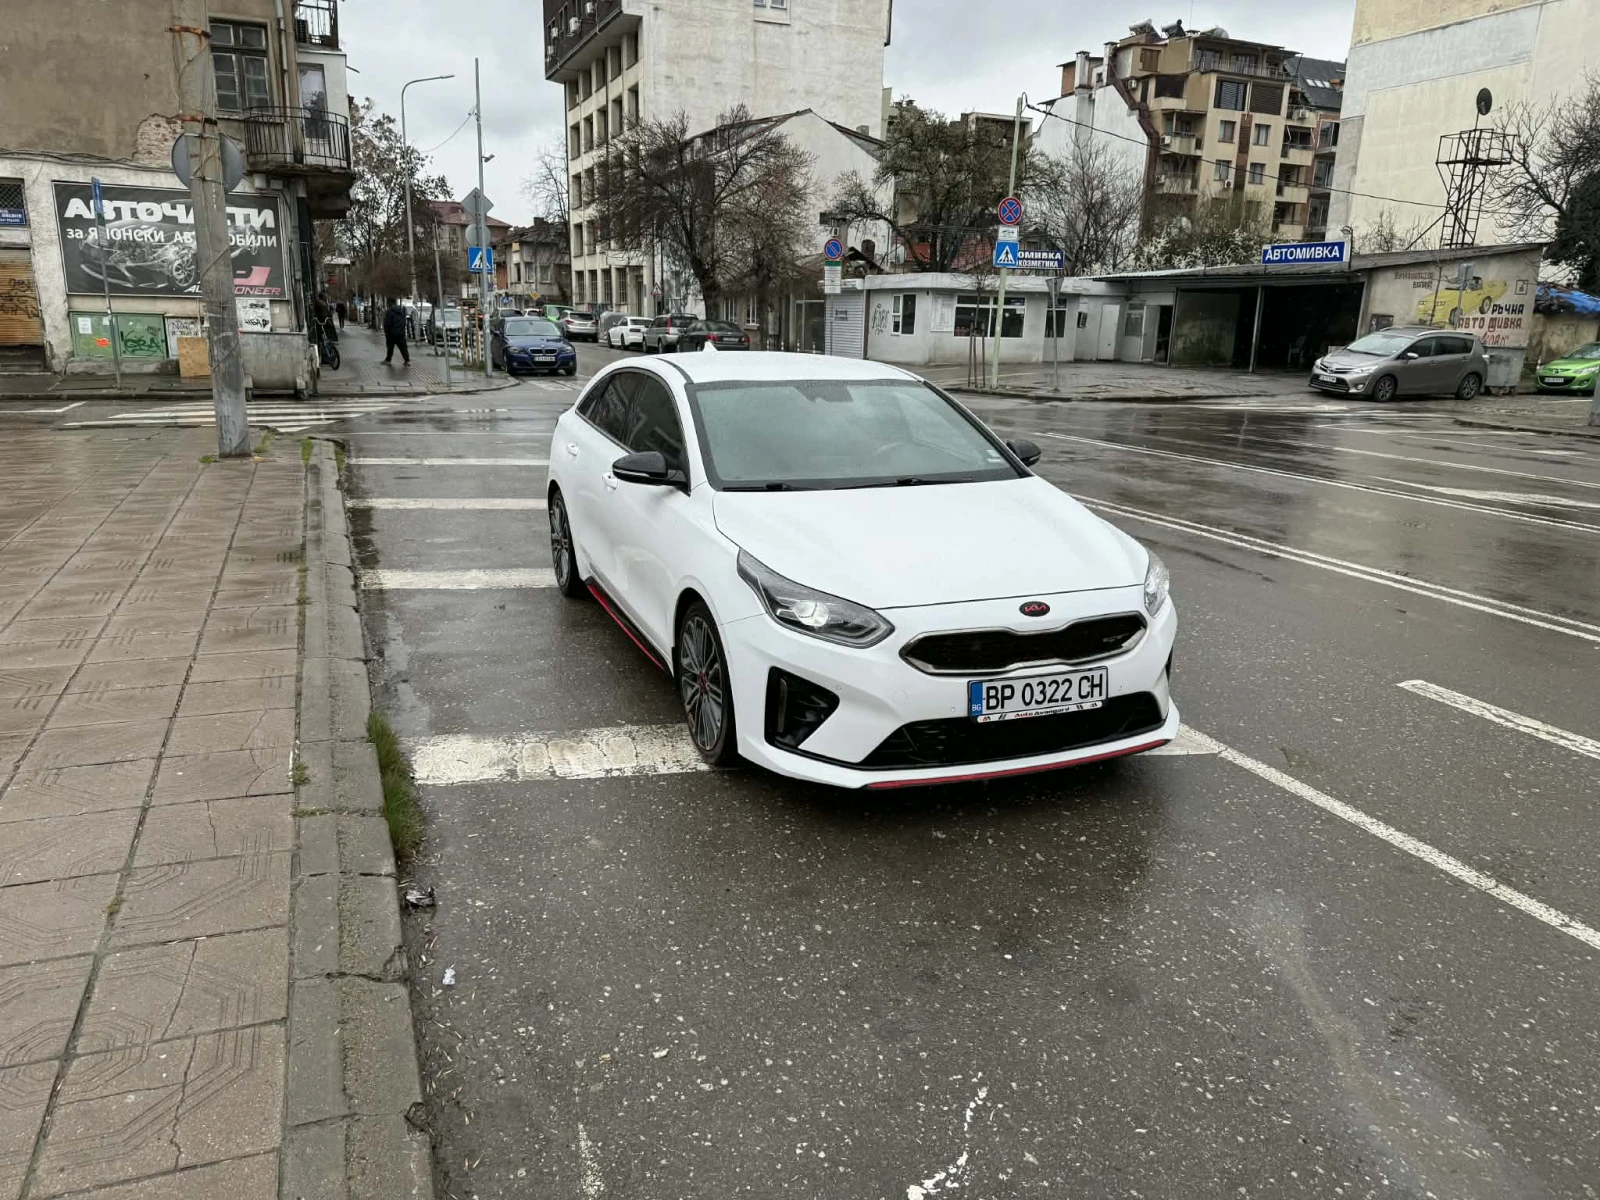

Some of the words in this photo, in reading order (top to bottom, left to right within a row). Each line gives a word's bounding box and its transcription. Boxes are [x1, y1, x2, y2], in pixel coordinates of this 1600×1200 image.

[64, 198, 276, 229] АВТОЧТИ
[66, 228, 83, 239] за
[1265, 245, 1340, 261] АВТОМИВКА
[1491, 304, 1525, 315] РЪЧНА
[986, 684, 1015, 710] BP
[1021, 678, 1073, 706] 0322
[1078, 673, 1103, 700] CH
[972, 703, 982, 711] BG
